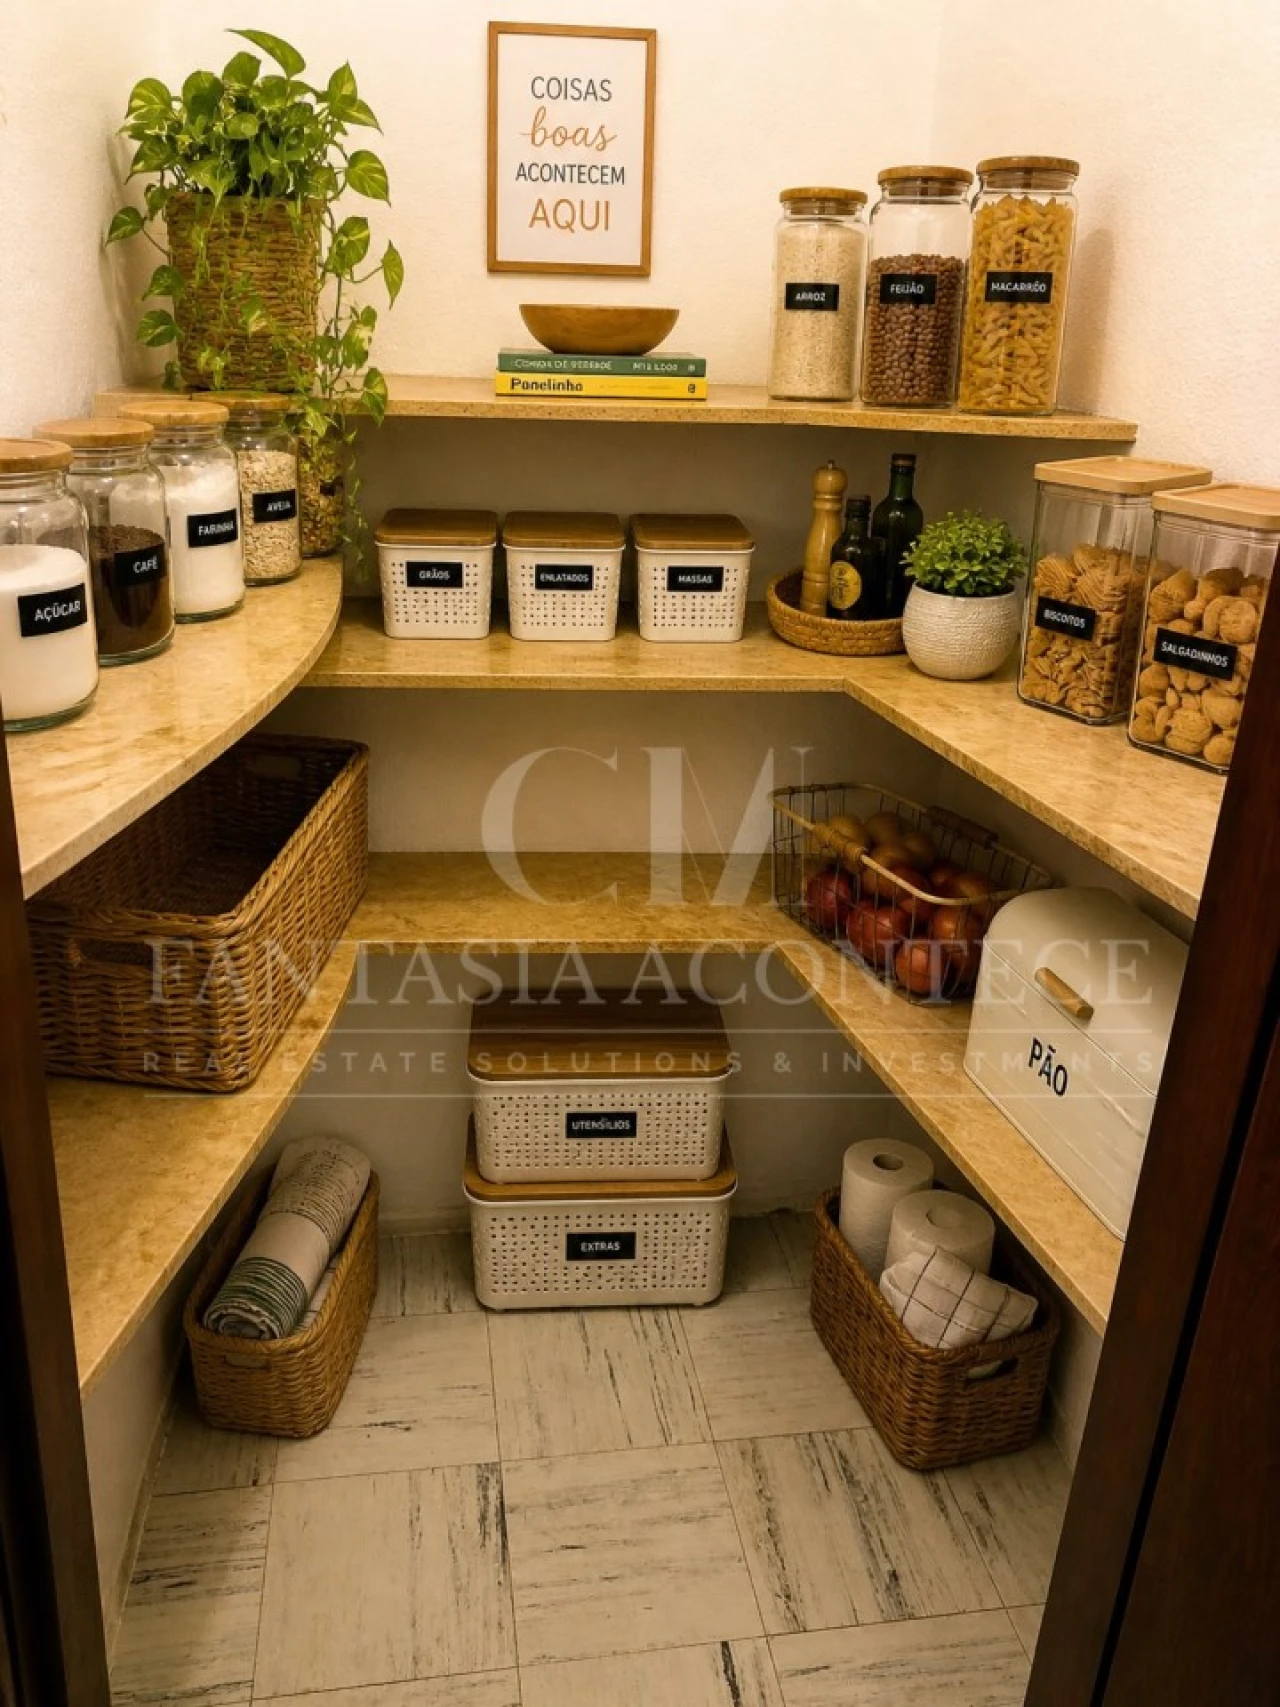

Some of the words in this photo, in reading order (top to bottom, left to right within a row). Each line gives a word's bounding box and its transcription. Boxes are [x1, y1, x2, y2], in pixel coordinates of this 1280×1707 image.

[531, 76, 613, 102] COISAS
[519, 105, 618, 152] boas
[515, 162, 626, 186] ACONTECEM
[529, 198, 611, 234] AQUI
[795, 291, 826, 302] ARROZ
[510, 377, 584, 392] Panelinha
[266, 500, 292, 512] AVEIA
[132, 555, 159, 574] CAFÉ
[418, 567, 451, 581] GRÃOS
[678, 574, 713, 584] MASSAS
[1043, 609, 1086, 629] BISCOITOS
[1161, 641, 1229, 668] SALGADINHOS
[1028, 1036, 1069, 1097] PÃO
[580, 1241, 620, 1253] EXTRAS
